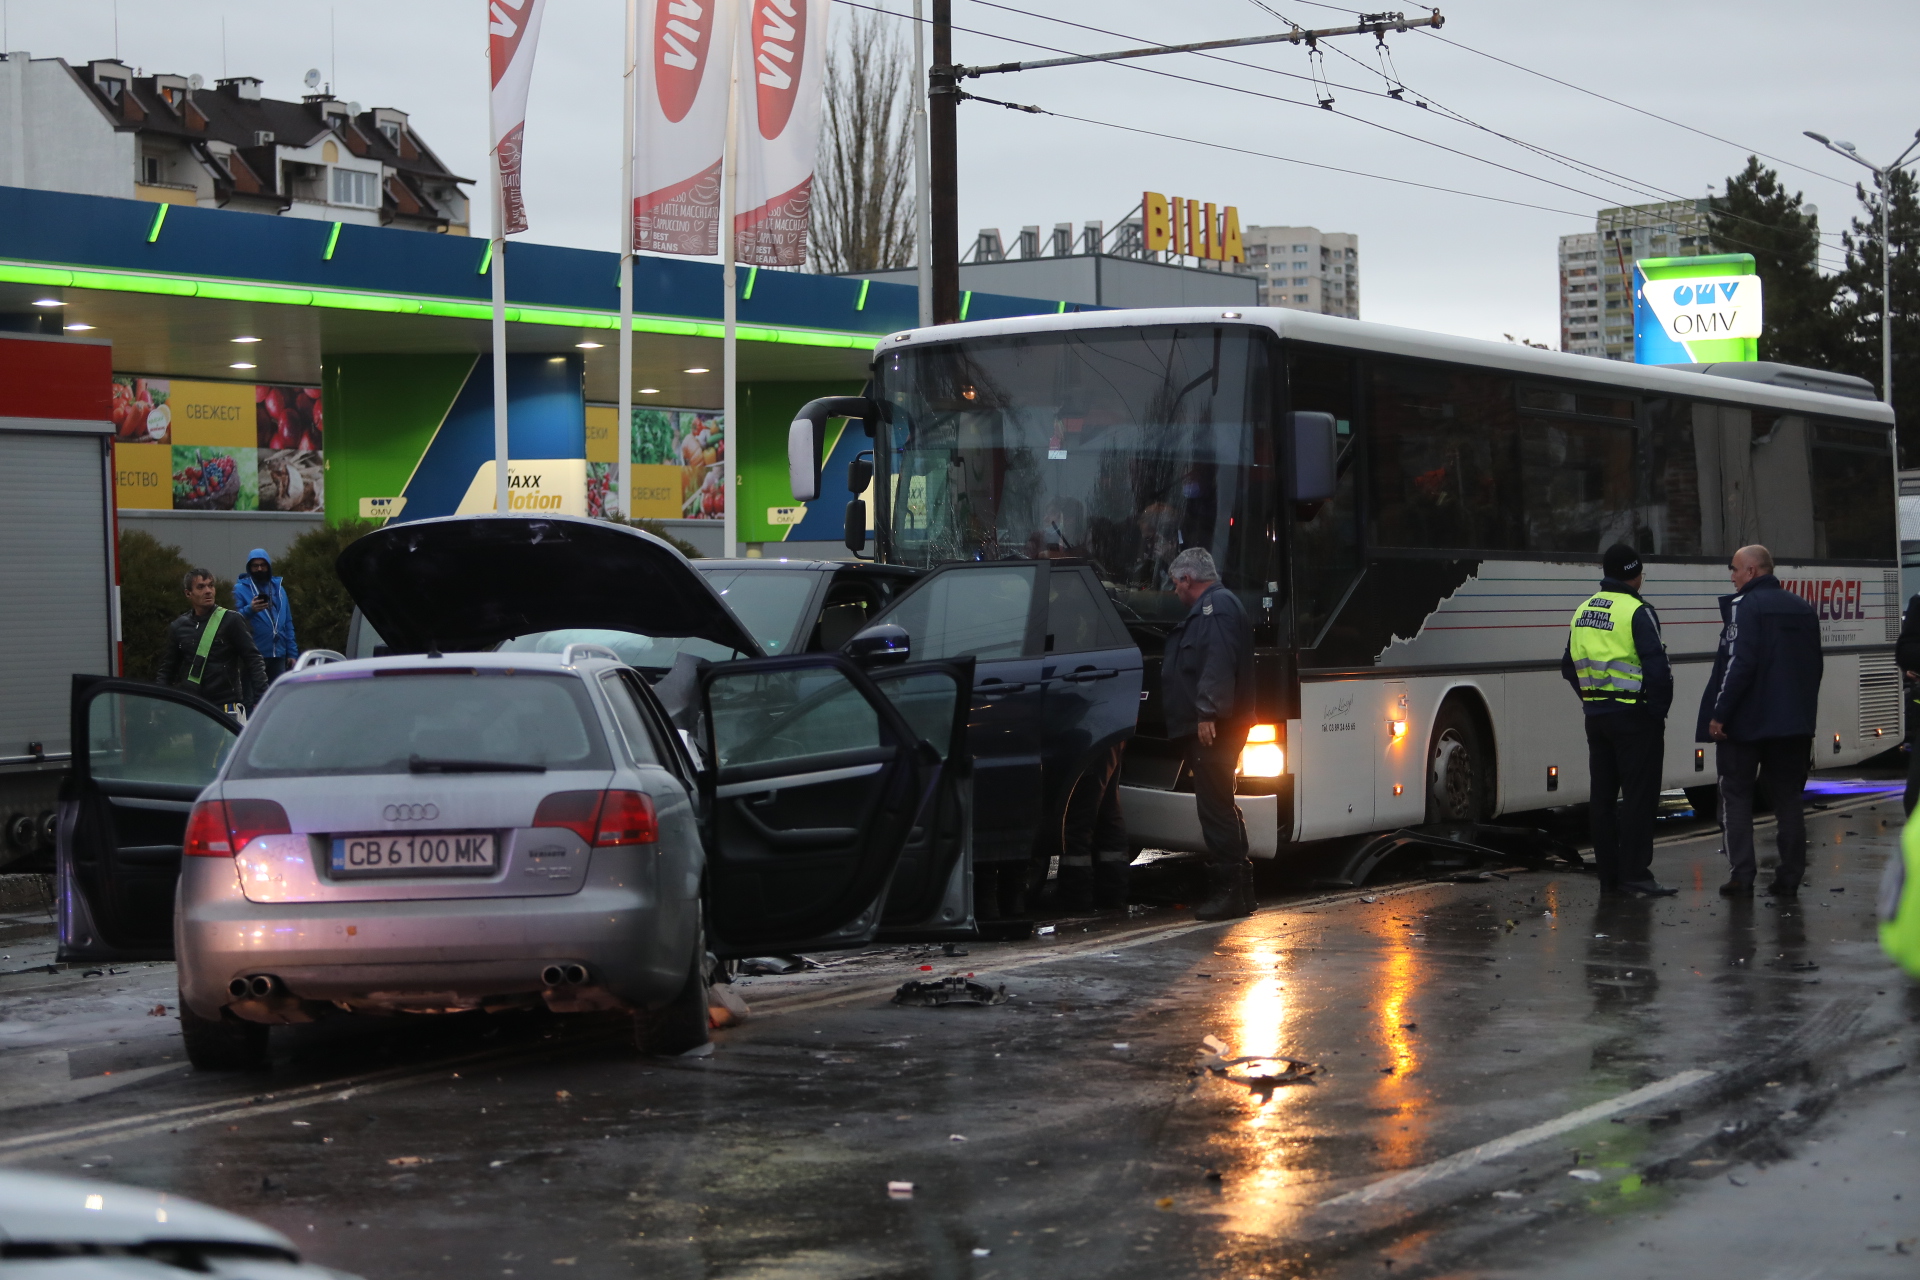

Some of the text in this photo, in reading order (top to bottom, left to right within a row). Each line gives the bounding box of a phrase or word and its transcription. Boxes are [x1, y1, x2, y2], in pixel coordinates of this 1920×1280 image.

[661, 203, 679, 217] LATTE
[680, 204, 719, 220] MACCHIATO
[653, 216, 690, 232] CAPPUCCINO
[1143, 191, 1245, 263] BILLA
[653, 231, 669, 241] BEST
[653, 241, 678, 252] BEANS
[755, 245, 772, 254] BEST
[755, 254, 777, 264] BEANS
[1673, 310, 1737, 335] OMV
[186, 404, 241, 420] СВЕЖЕСТ
[371, 508, 392, 516] OMV
[1589, 598, 1613, 608] СДВР
[1576, 618, 1614, 630] ПОЛИЦИЯ
